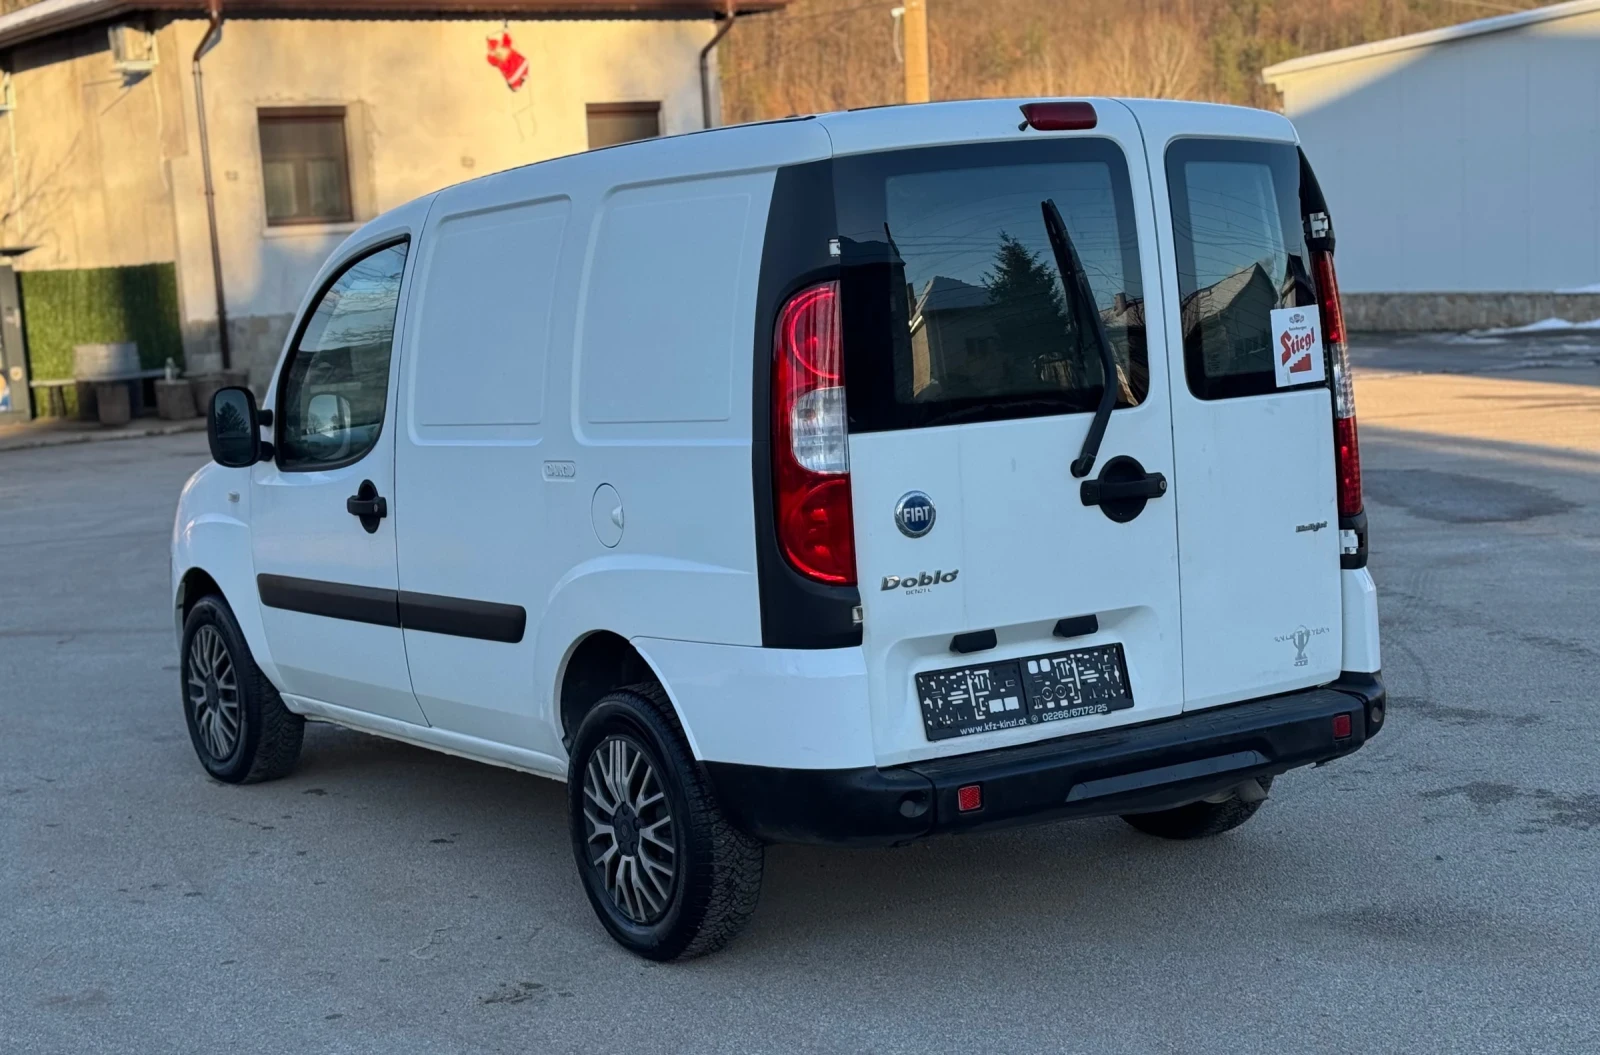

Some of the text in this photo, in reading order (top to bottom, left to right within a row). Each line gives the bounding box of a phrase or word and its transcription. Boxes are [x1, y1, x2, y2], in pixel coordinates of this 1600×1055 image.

[1280, 327, 1315, 367] Stiegl
[903, 506, 930, 523] FIAT
[959, 703, 1108, 735] www.kfz-kinzl.at 02266/67172/25
